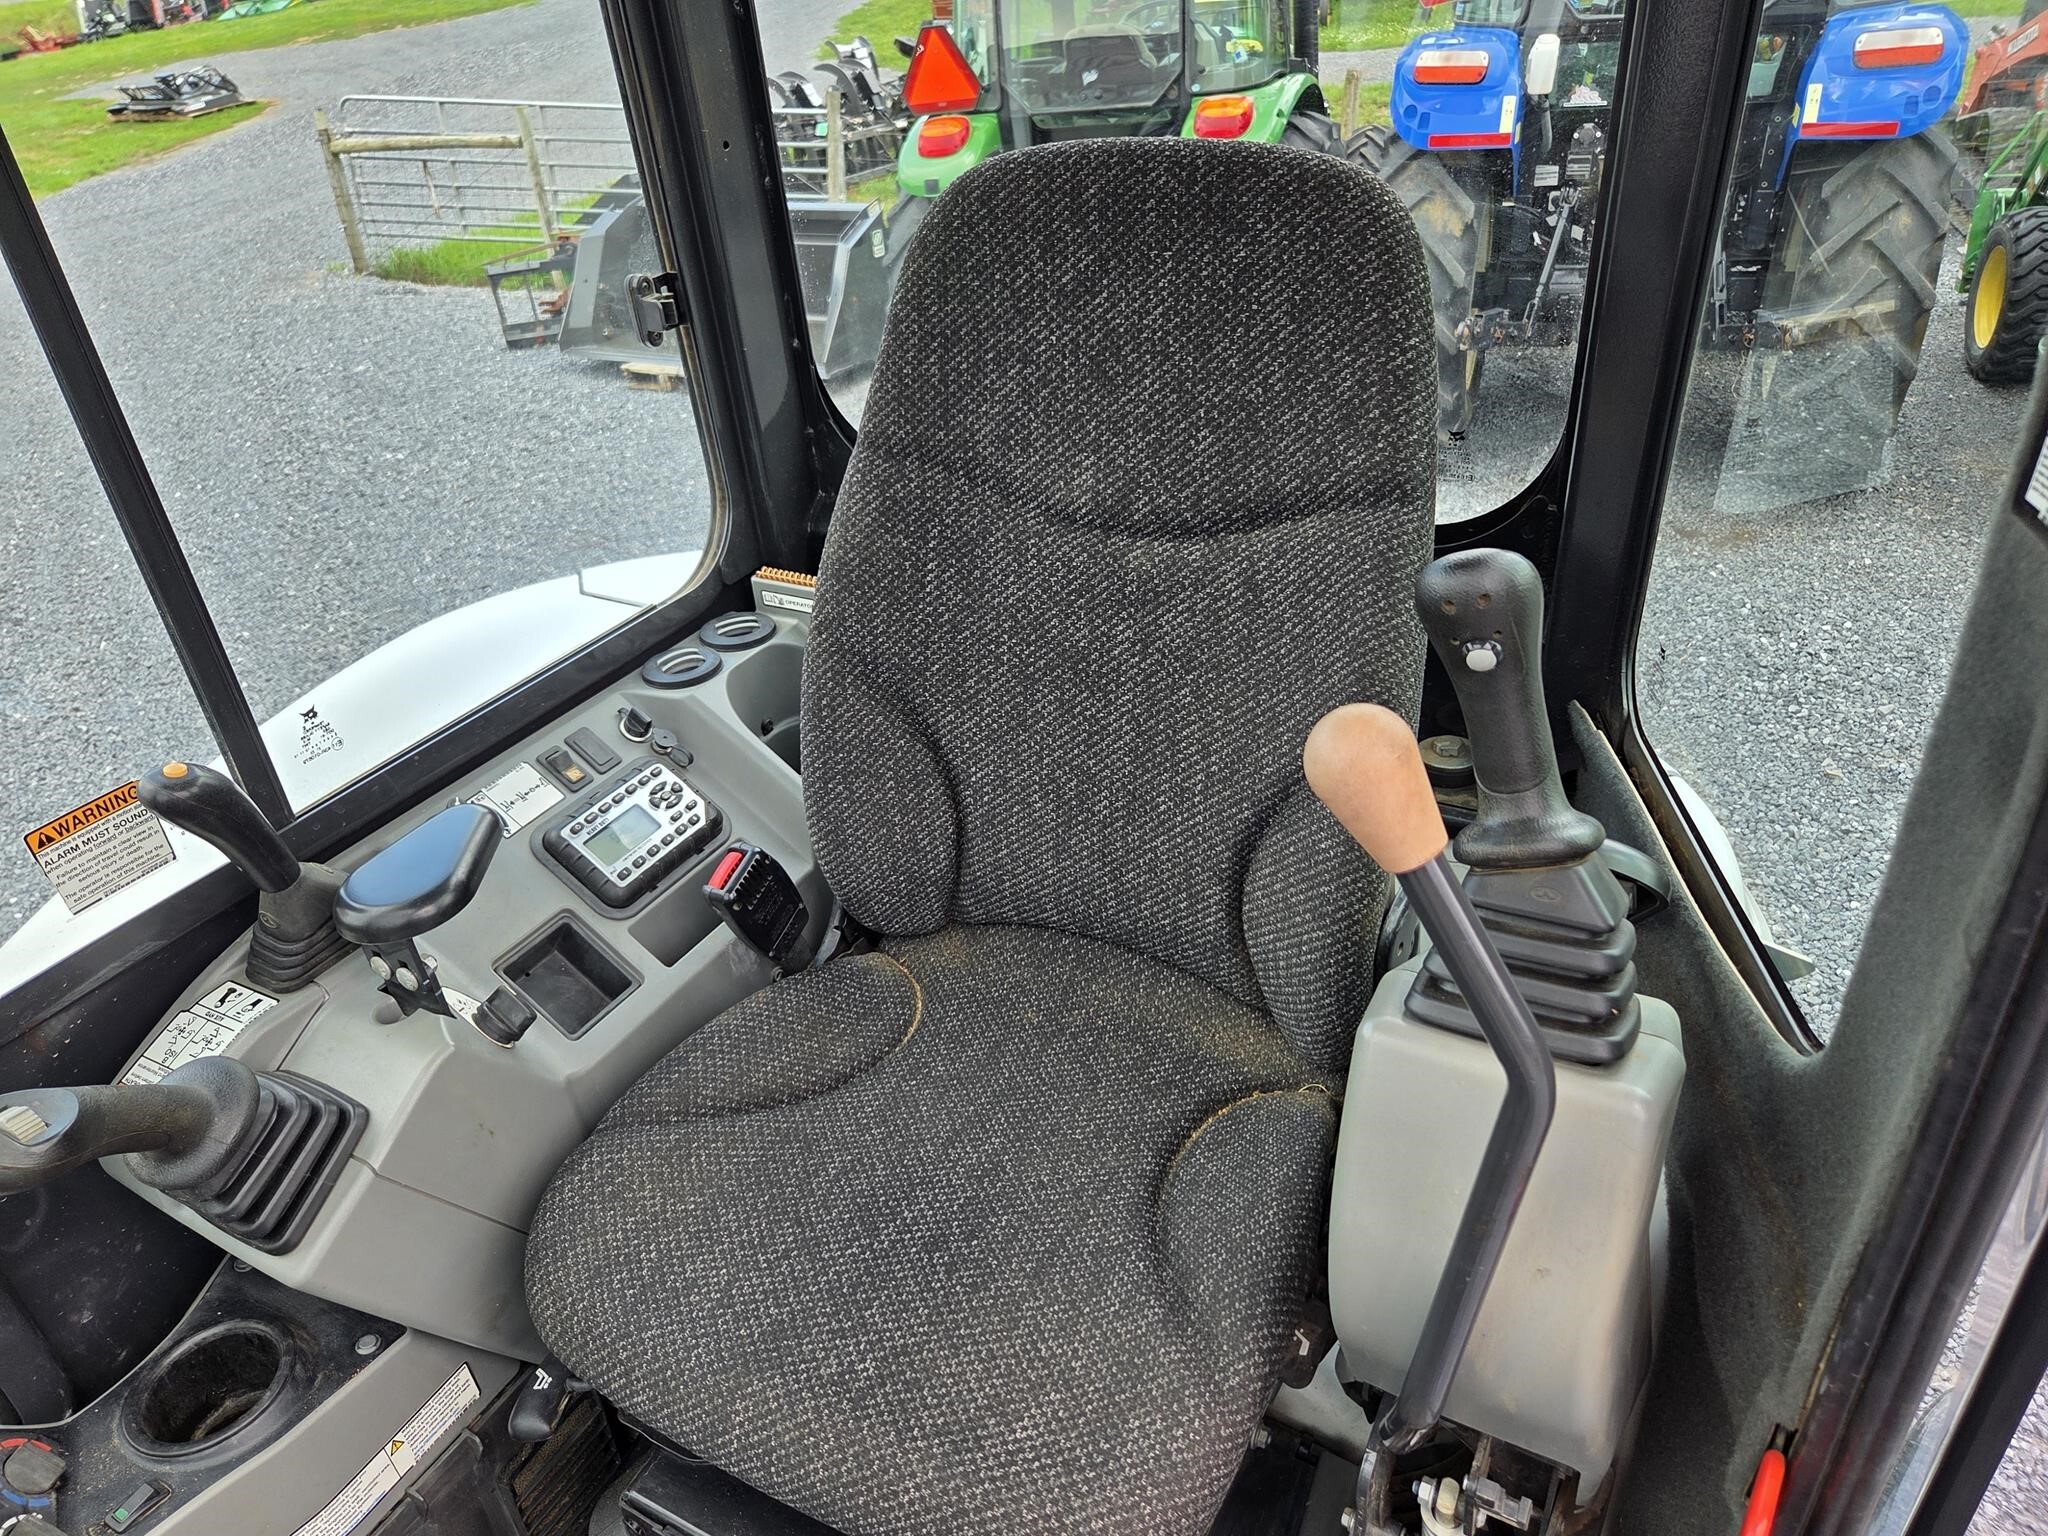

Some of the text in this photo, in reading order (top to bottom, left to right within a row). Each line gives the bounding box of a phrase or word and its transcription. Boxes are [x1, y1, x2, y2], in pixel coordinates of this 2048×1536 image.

[51, 786, 138, 838] WARNING
[38, 851, 50, 860] This
[50, 840, 72, 853] machine
[44, 808, 149, 869] ALARM MUST SOUND
[46, 863, 64, 875] when
[63, 846, 94, 865] operating
[93, 833, 118, 848] forward
[55, 880, 67, 888] the
[67, 865, 94, 882] direction
[101, 850, 119, 862] travel
[119, 841, 137, 853] could
[136, 832, 153, 844] result
[56, 866, 78, 880] Failure
[86, 847, 112, 863] maintain
[117, 836, 132, 846] clear
[132, 830, 147, 838] view
[65, 891, 78, 900] The
[78, 877, 104, 893] operator
[110, 854, 145, 874] responsible
[153, 843, 164, 851] the
[73, 893, 87, 903] safe
[87, 877, 116, 896] operation
[123, 867, 136, 875] this
[78, 868, 101, 883] serious
[100, 860, 118, 871] injury
